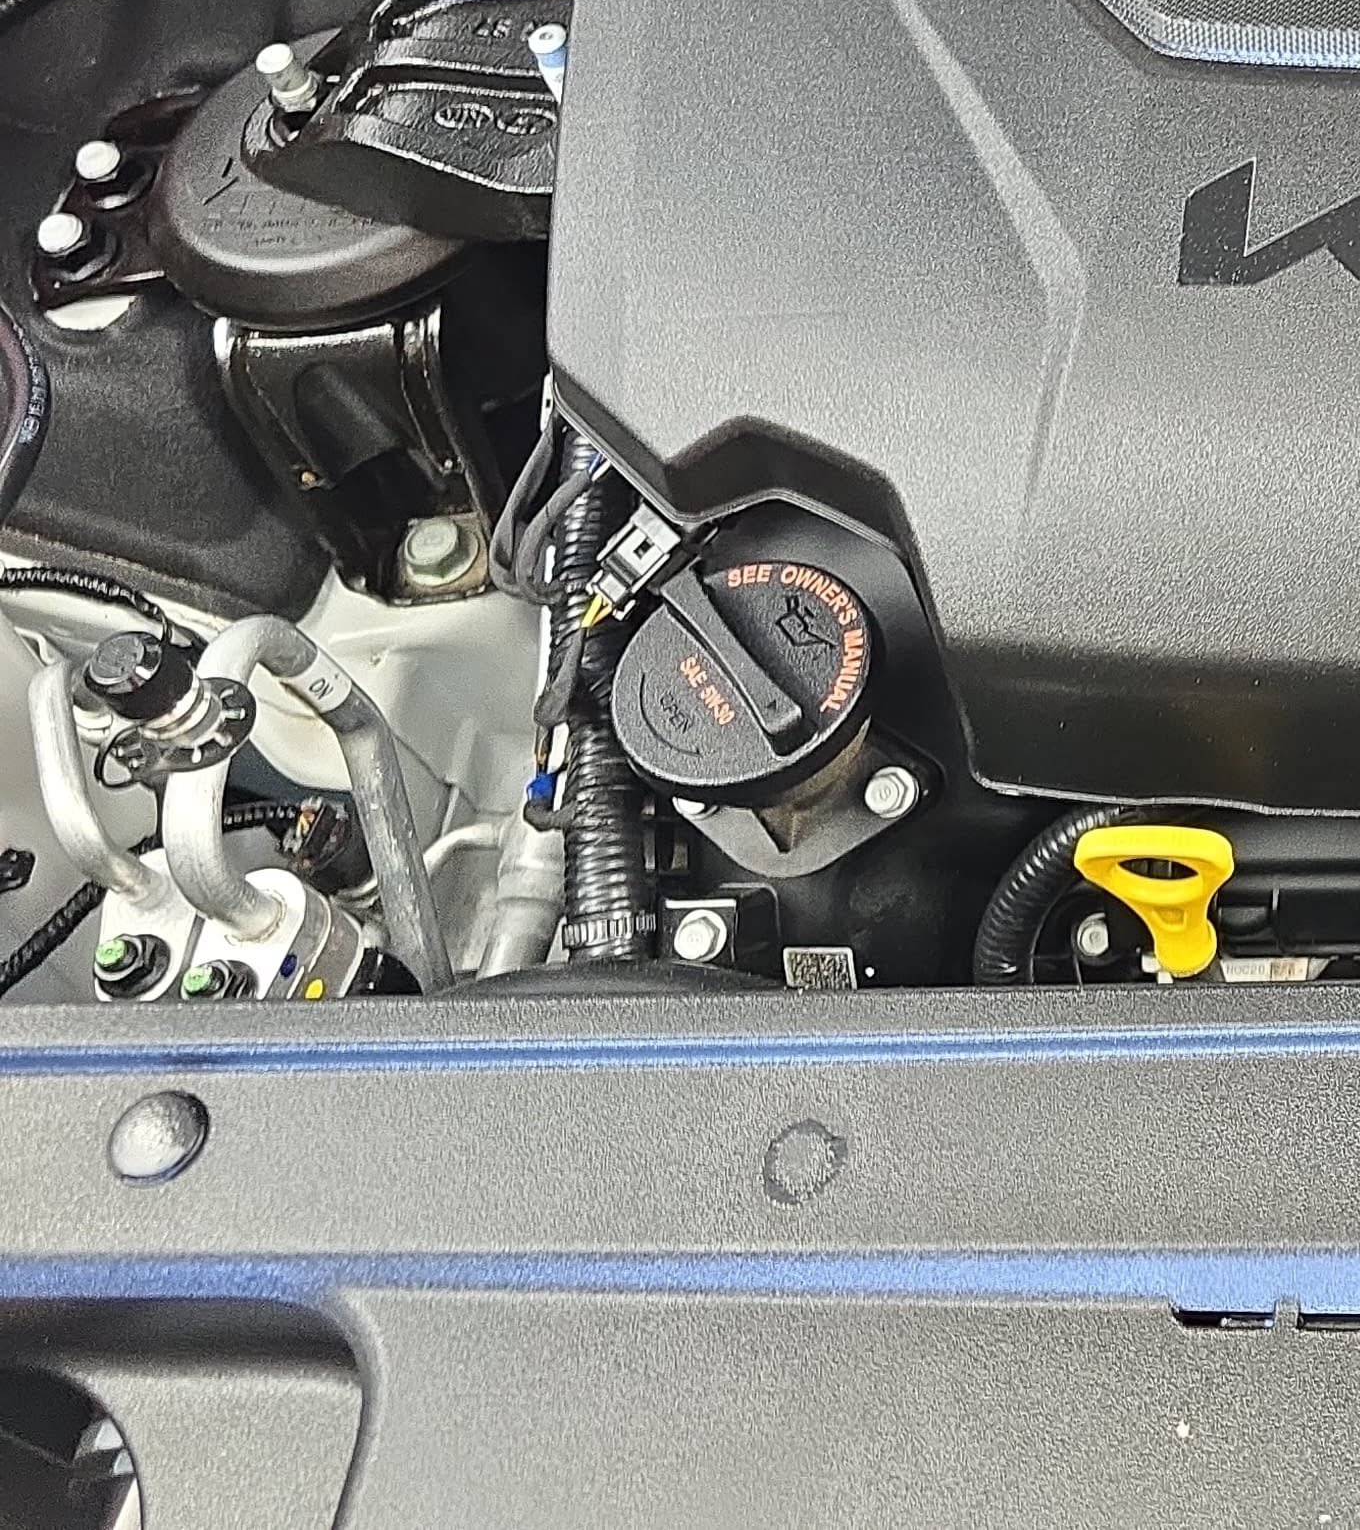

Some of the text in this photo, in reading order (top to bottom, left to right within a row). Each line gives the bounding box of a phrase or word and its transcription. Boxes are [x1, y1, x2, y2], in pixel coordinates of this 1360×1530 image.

[680, 656, 708, 688] SAE
[727, 564, 864, 713] SEE OWNER'S MANUAL
